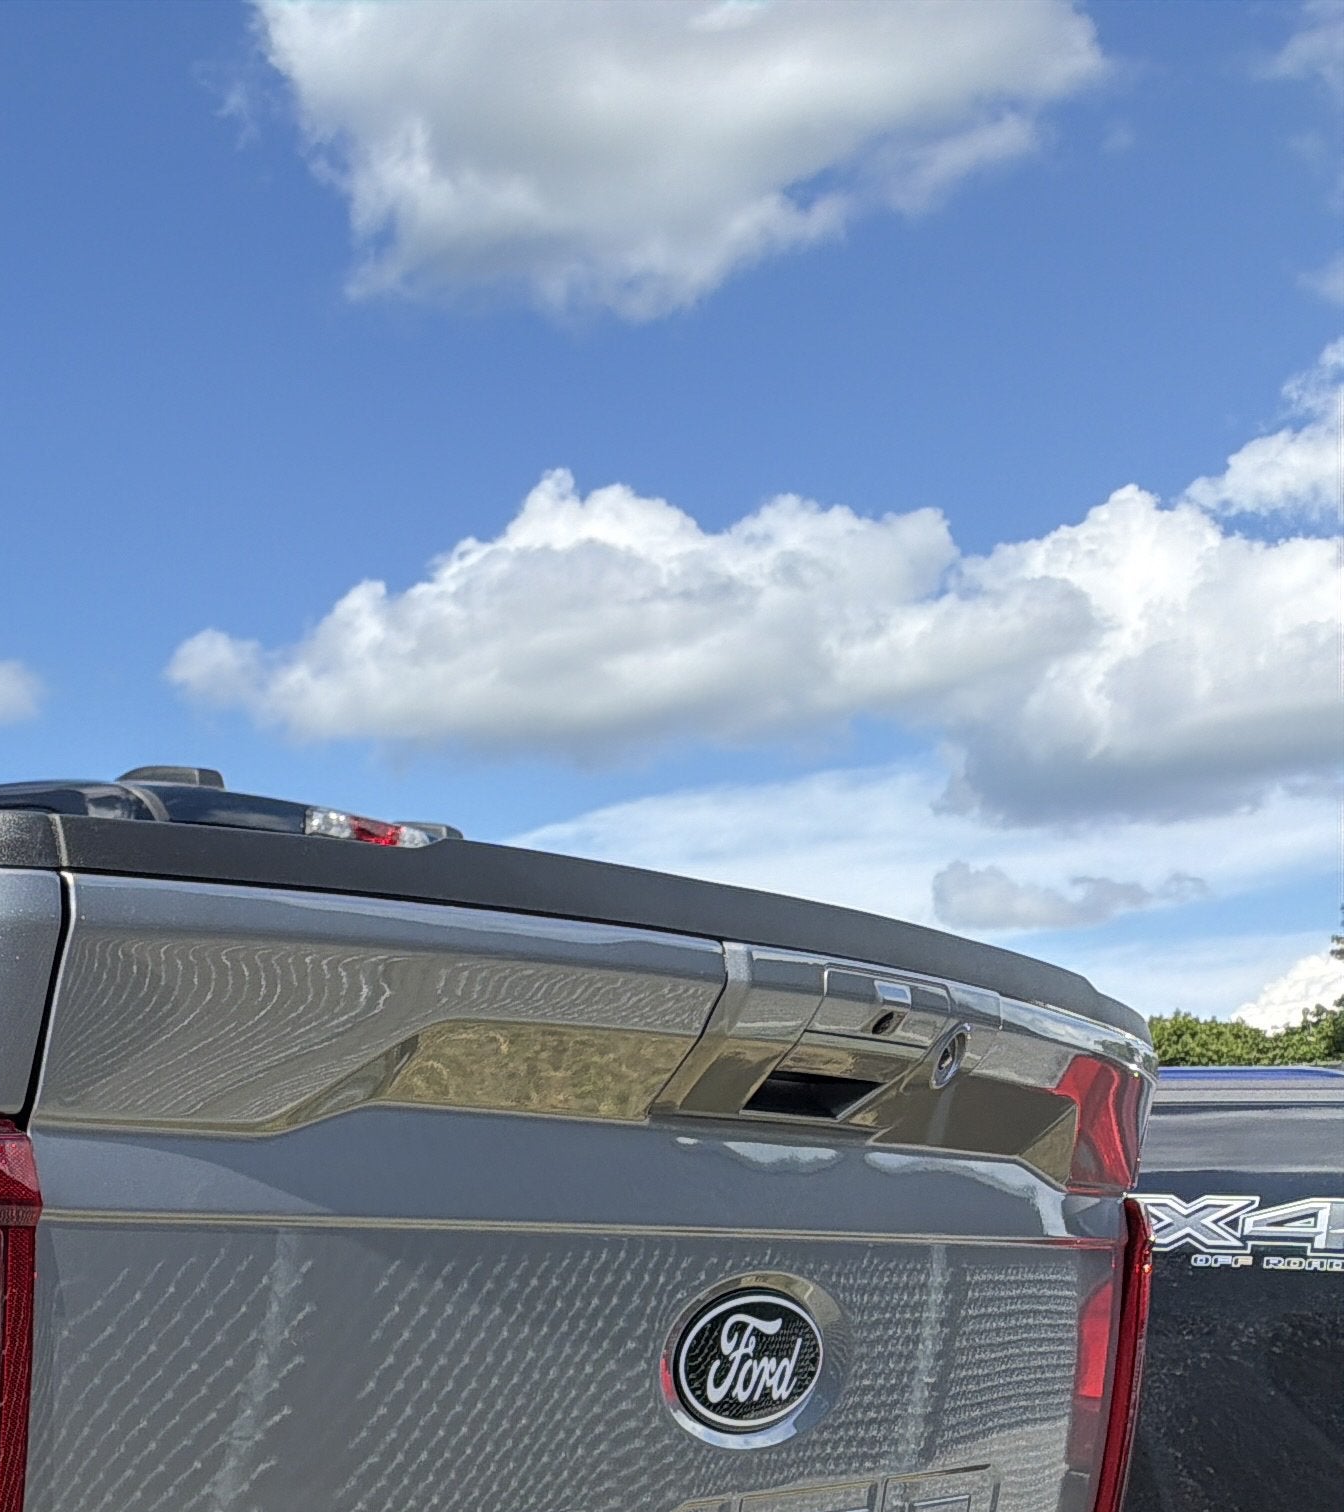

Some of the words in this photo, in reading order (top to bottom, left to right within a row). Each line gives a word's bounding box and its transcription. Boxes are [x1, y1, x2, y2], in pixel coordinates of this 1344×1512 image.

[1123, 1193, 1344, 1257] X4
[1190, 1254, 1253, 1268] OFF
[1263, 1256, 1344, 1272] ROAD
[706, 1313, 803, 1403] Ford
